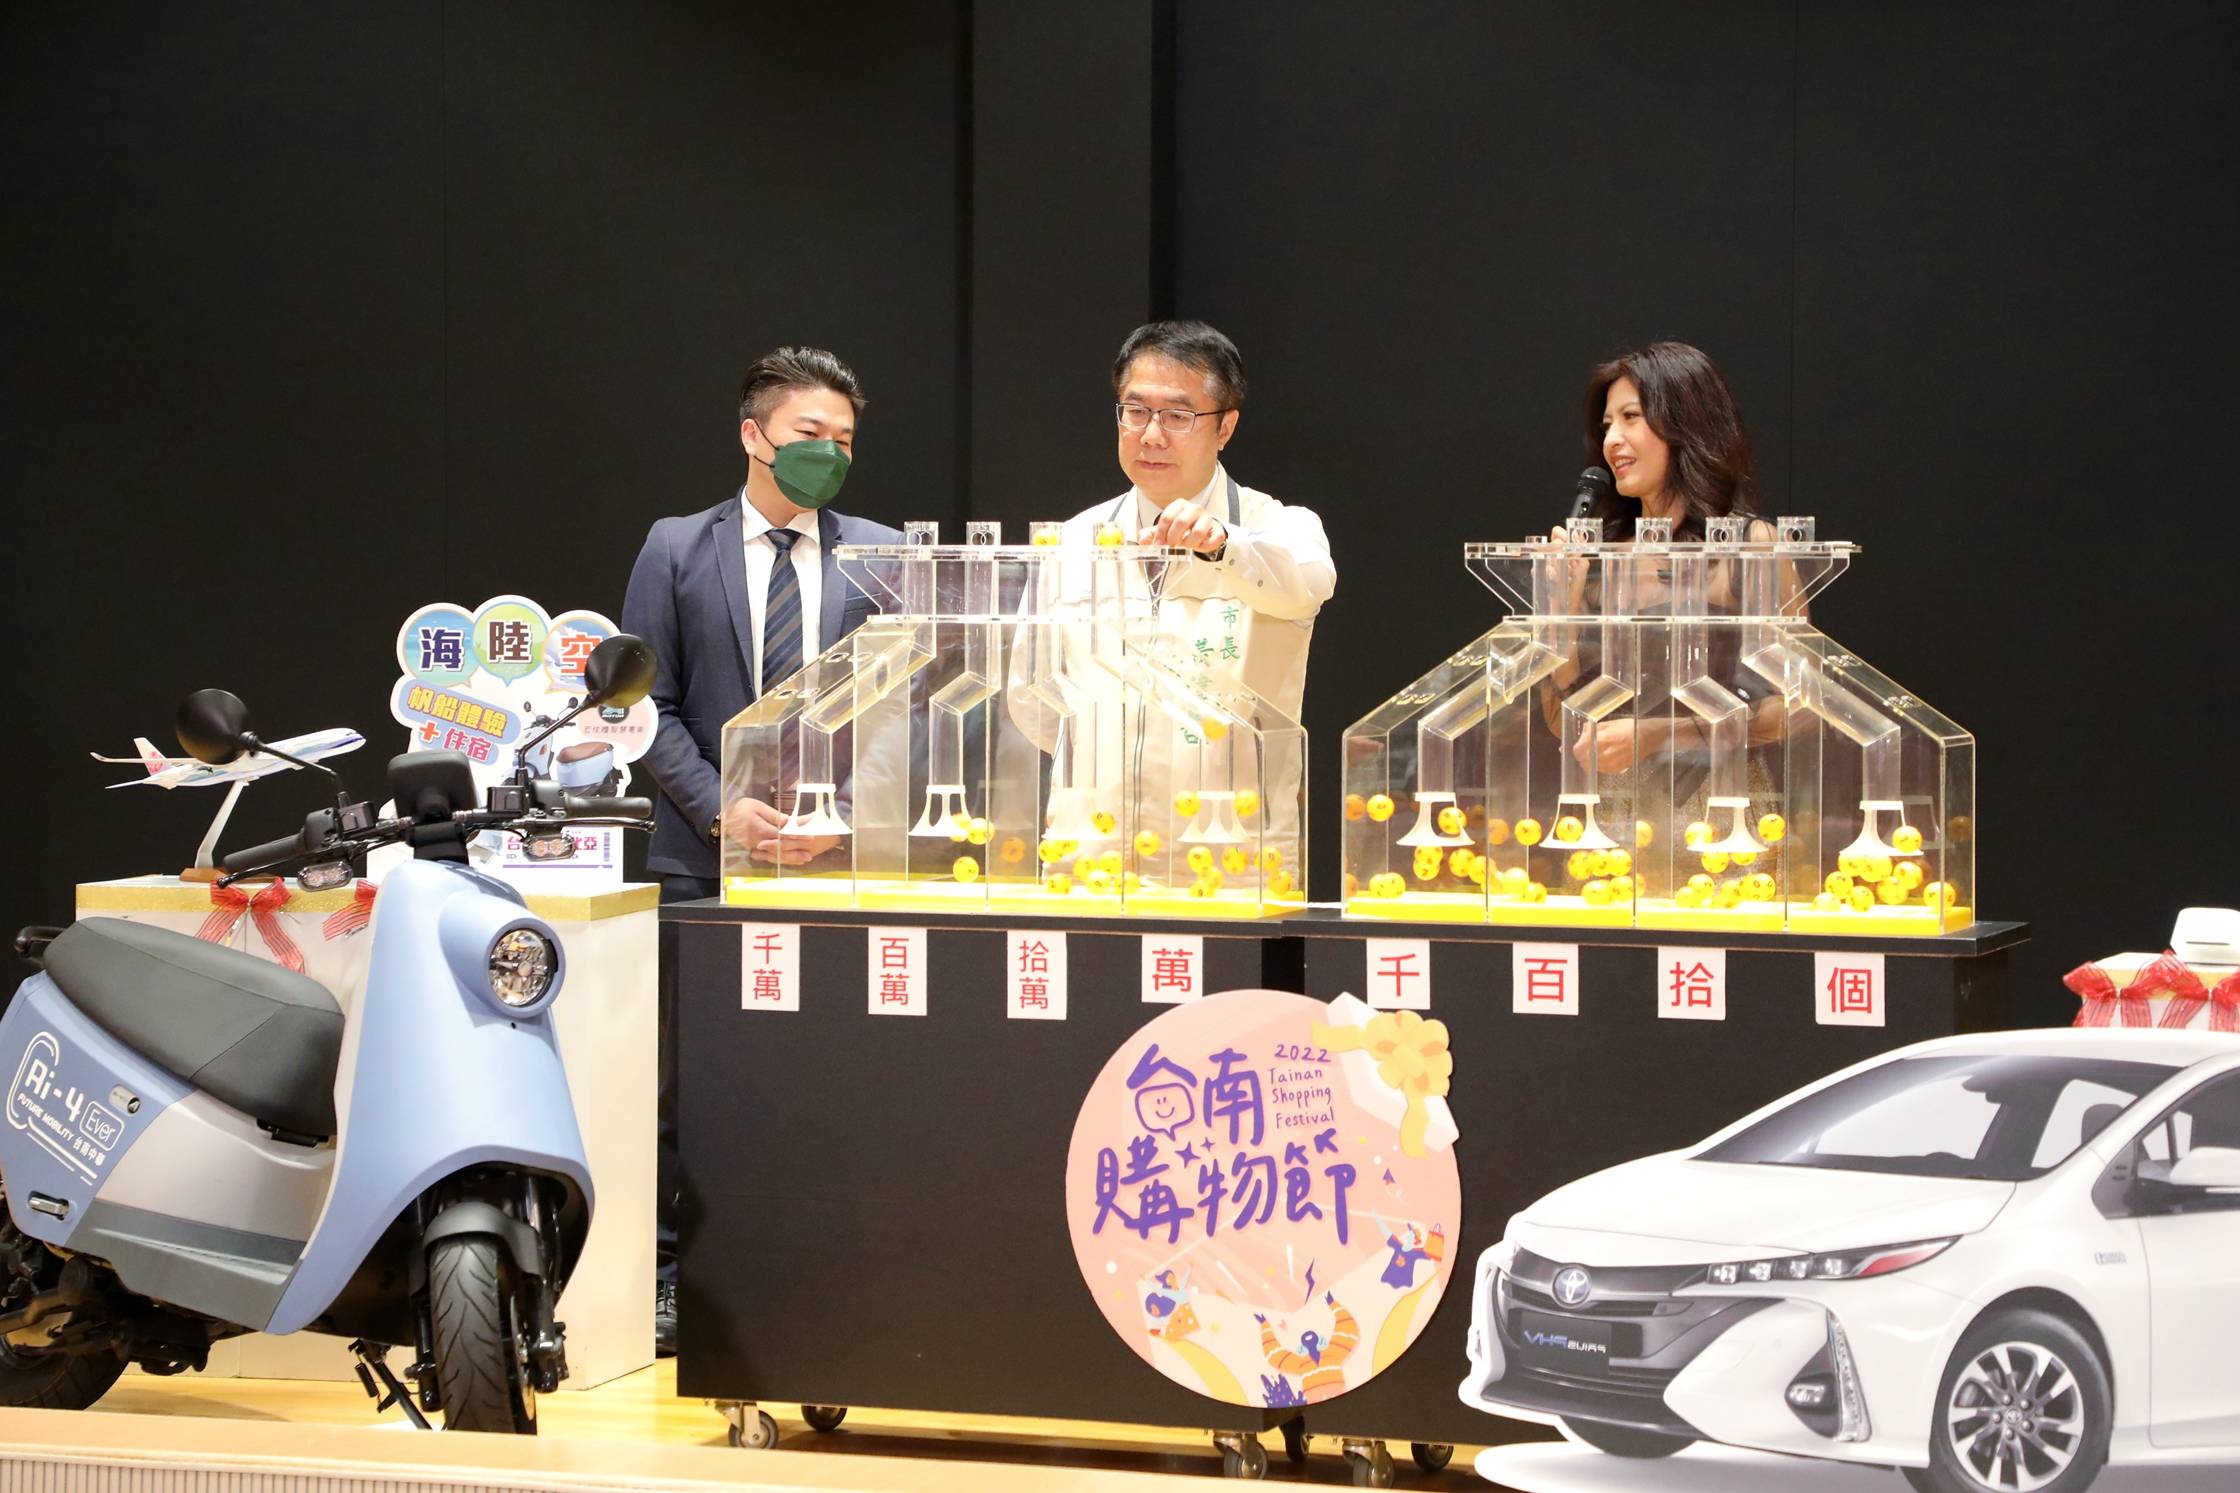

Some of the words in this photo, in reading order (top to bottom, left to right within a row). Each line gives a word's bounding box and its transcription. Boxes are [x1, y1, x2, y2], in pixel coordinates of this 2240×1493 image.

[407, 685, 508, 739] 帆船體驗
[753, 933, 782, 1001] 千萬
[879, 937, 910, 1005] 百萬
[1019, 940, 1049, 1009] 拾萬
[1151, 948, 1193, 993] 萬
[1377, 953, 1420, 998] 千
[1524, 957, 1568, 1003] 百
[1669, 961, 1714, 1009] 拾
[1827, 966, 1872, 1014] 個
[1268, 1067, 1323, 1085] Tainan
[1274, 1044, 1331, 1063] 2022
[25, 1058, 85, 1122] Ai-4
[1126, 1043, 1265, 1146] 台南
[1272, 1085, 1331, 1108] Shopping
[17, 1093, 44, 1118] FUTURE
[41, 1113, 75, 1141] MOBILITY
[85, 1109, 116, 1142] Ever
[1276, 1106, 1335, 1129] Festival
[1092, 1128, 1357, 1246] 購物節
